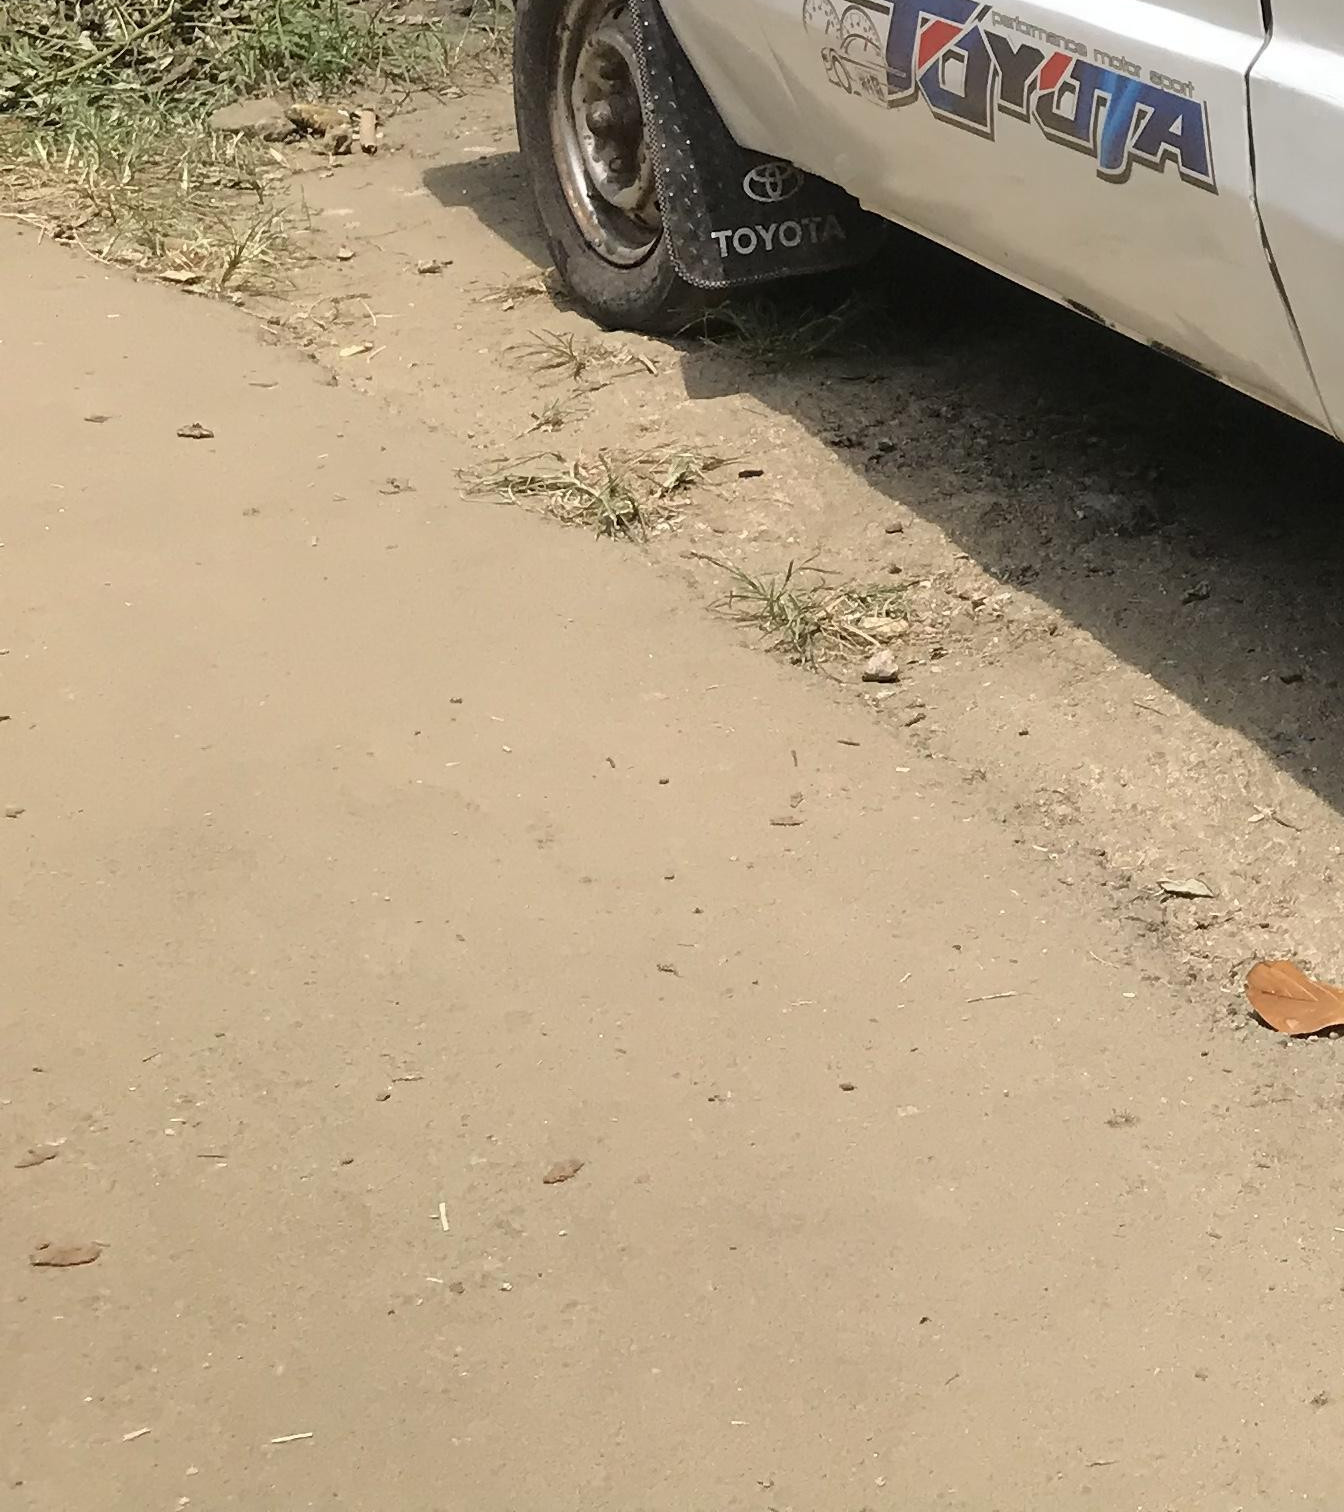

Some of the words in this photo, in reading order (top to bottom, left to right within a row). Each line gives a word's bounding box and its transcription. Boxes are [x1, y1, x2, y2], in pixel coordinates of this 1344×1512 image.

[1093, 47, 1142, 80] motor
[1149, 69, 1196, 99] sport
[710, 214, 847, 258] TOYOTA
